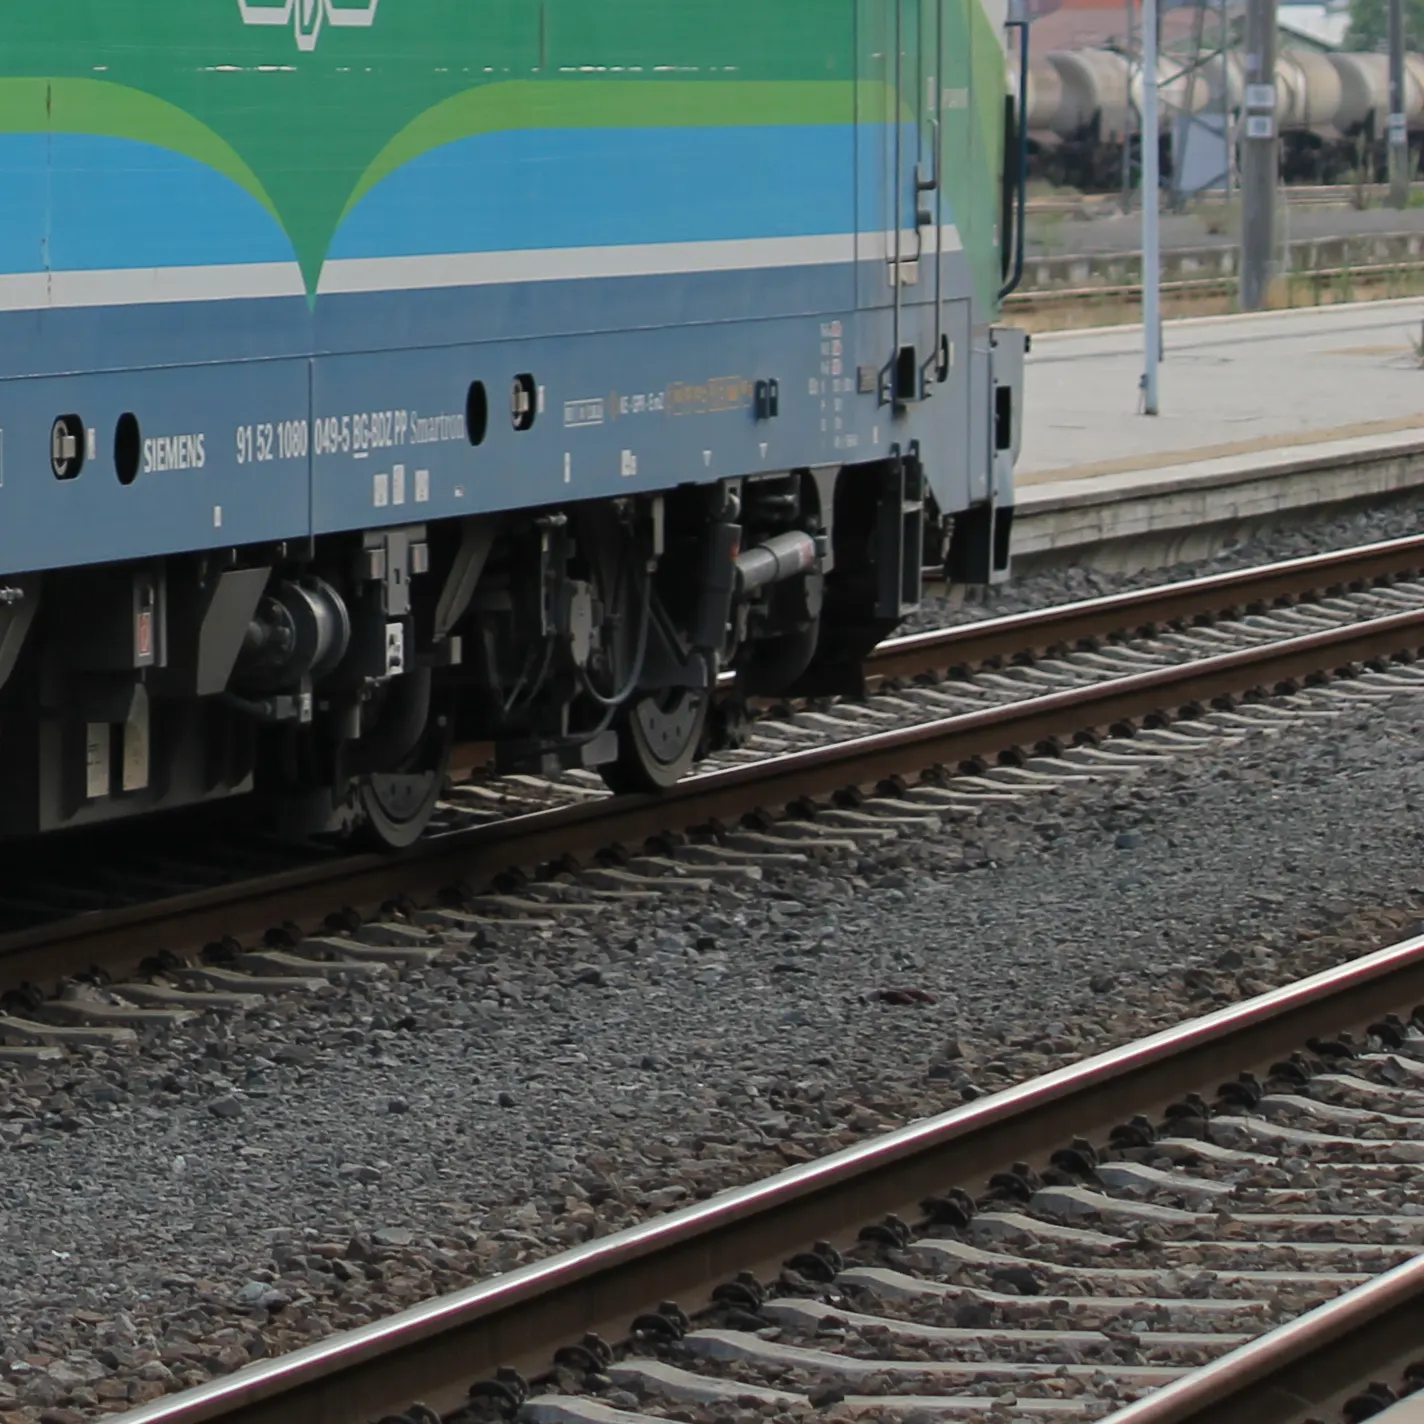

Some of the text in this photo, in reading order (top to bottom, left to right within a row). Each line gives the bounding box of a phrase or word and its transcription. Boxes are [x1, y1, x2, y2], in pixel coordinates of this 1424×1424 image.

[143, 432, 206, 474] SIEMENS
[236, 426, 253, 464] 91
[256, 422, 273, 462] 52
[314, 414, 350, 455] 049-5
[394, 409, 407, 446] PP
